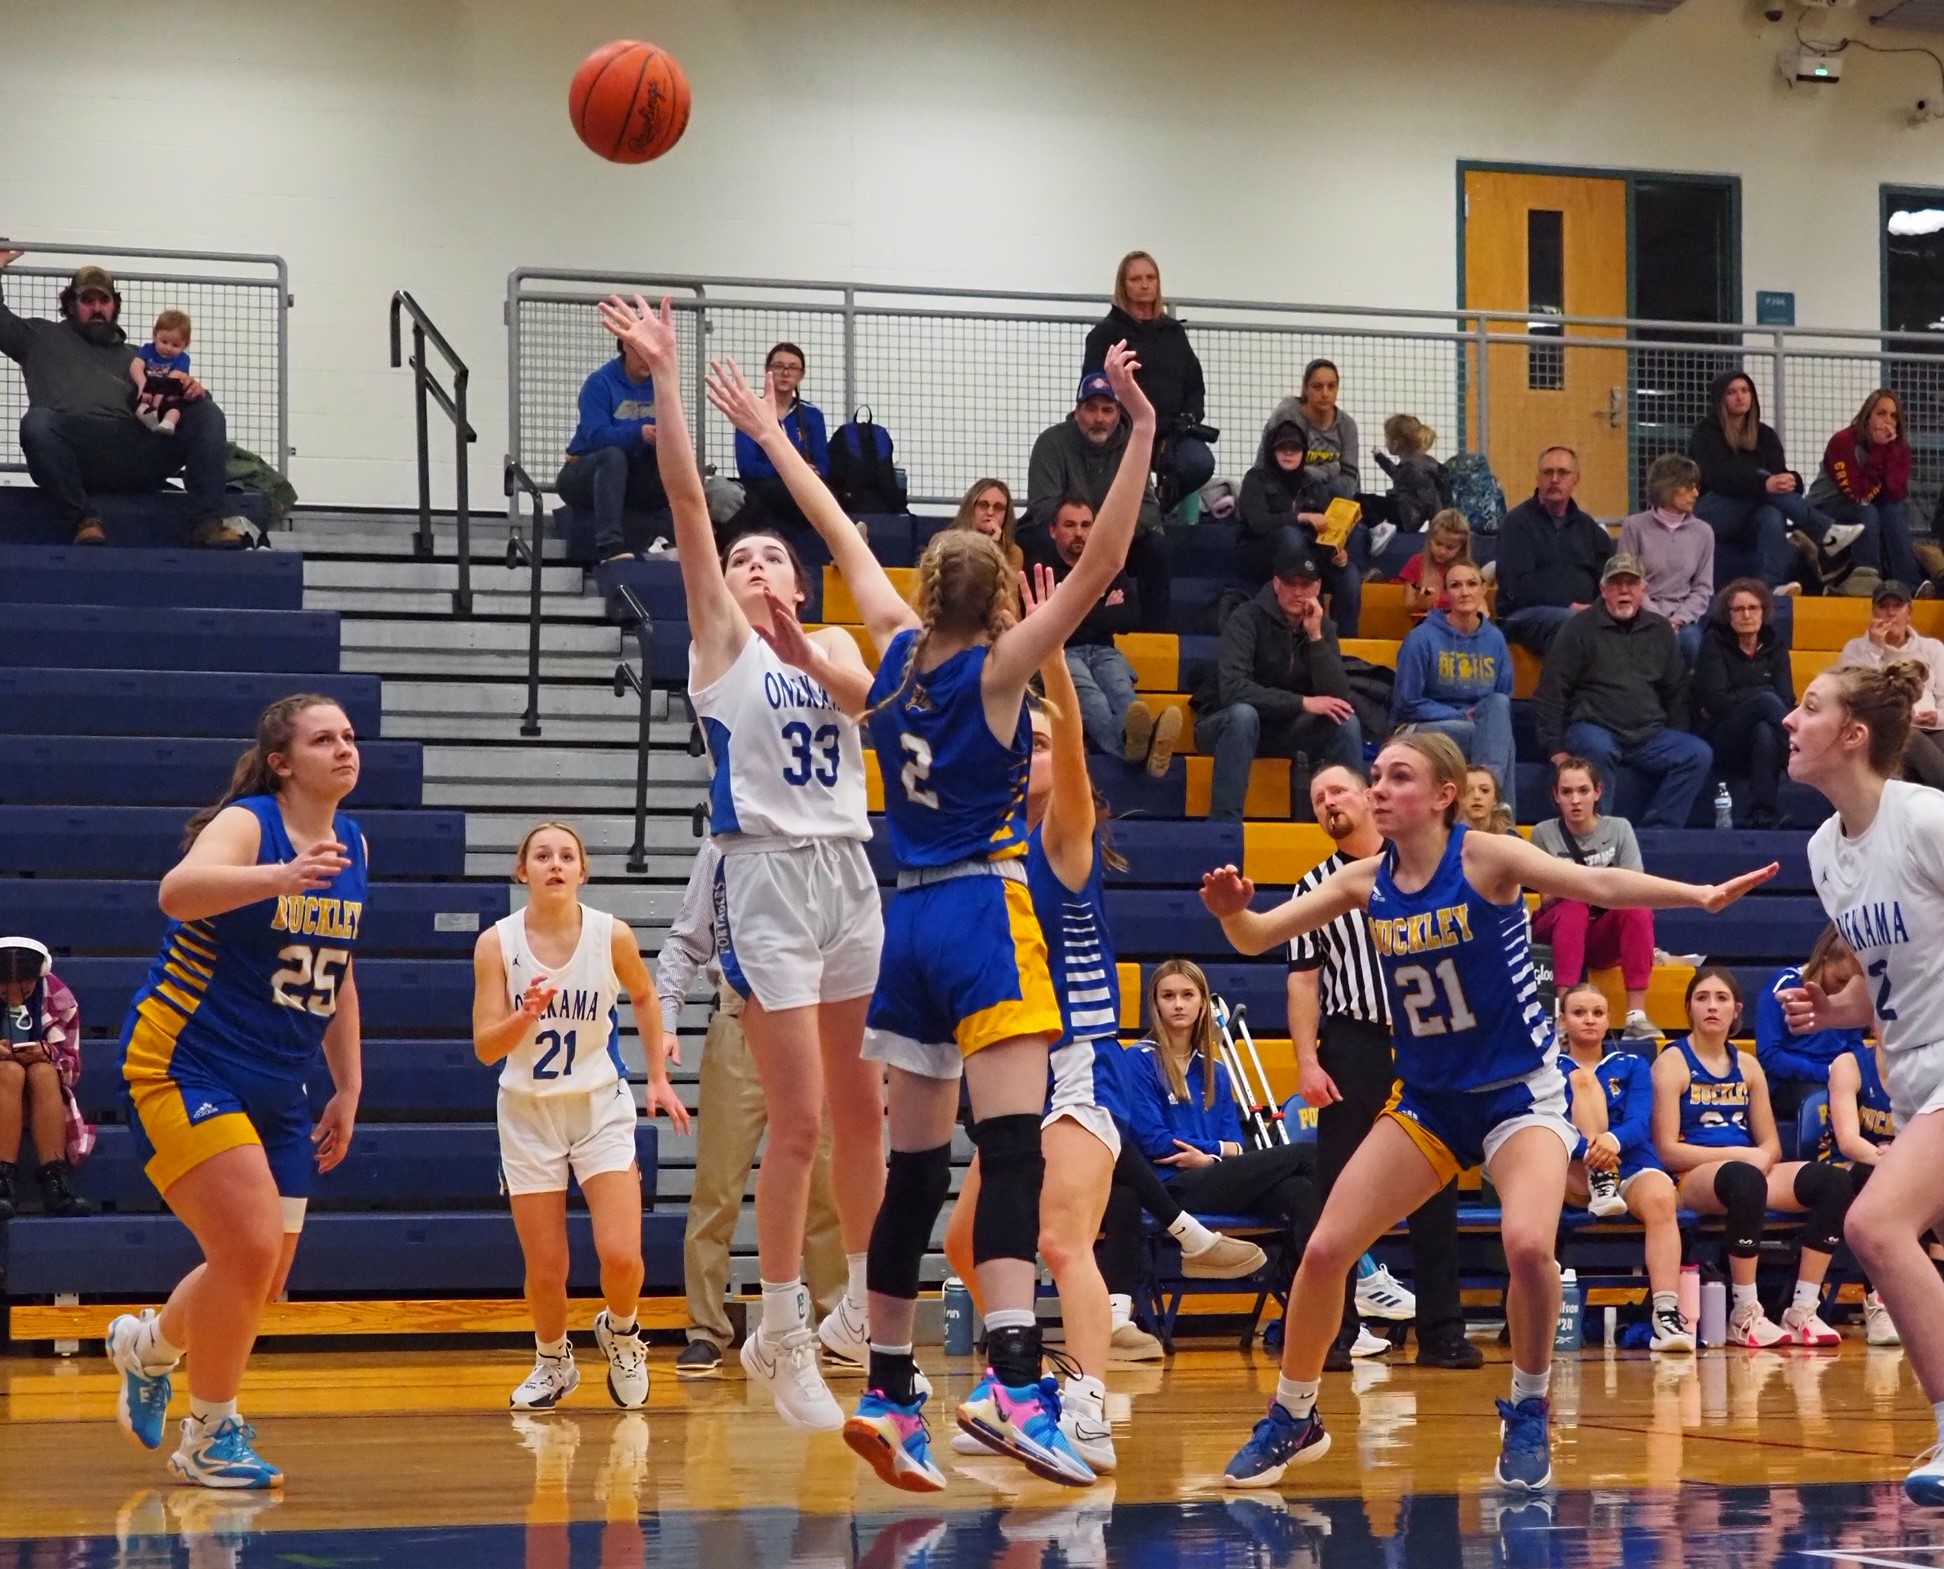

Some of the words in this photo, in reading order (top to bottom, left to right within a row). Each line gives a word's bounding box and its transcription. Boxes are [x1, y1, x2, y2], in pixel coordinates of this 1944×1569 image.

[764, 671, 842, 712] ONEKA
[781, 721, 840, 787] 33
[900, 732, 940, 810] 2
[1836, 901, 1910, 952] NEKAMA
[271, 944, 349, 1018] 25
[515, 989, 598, 1022] OKAMA
[1393, 957, 1478, 1037] 21
[1867, 958, 1898, 1021] 2
[532, 1029, 577, 1080] 21
